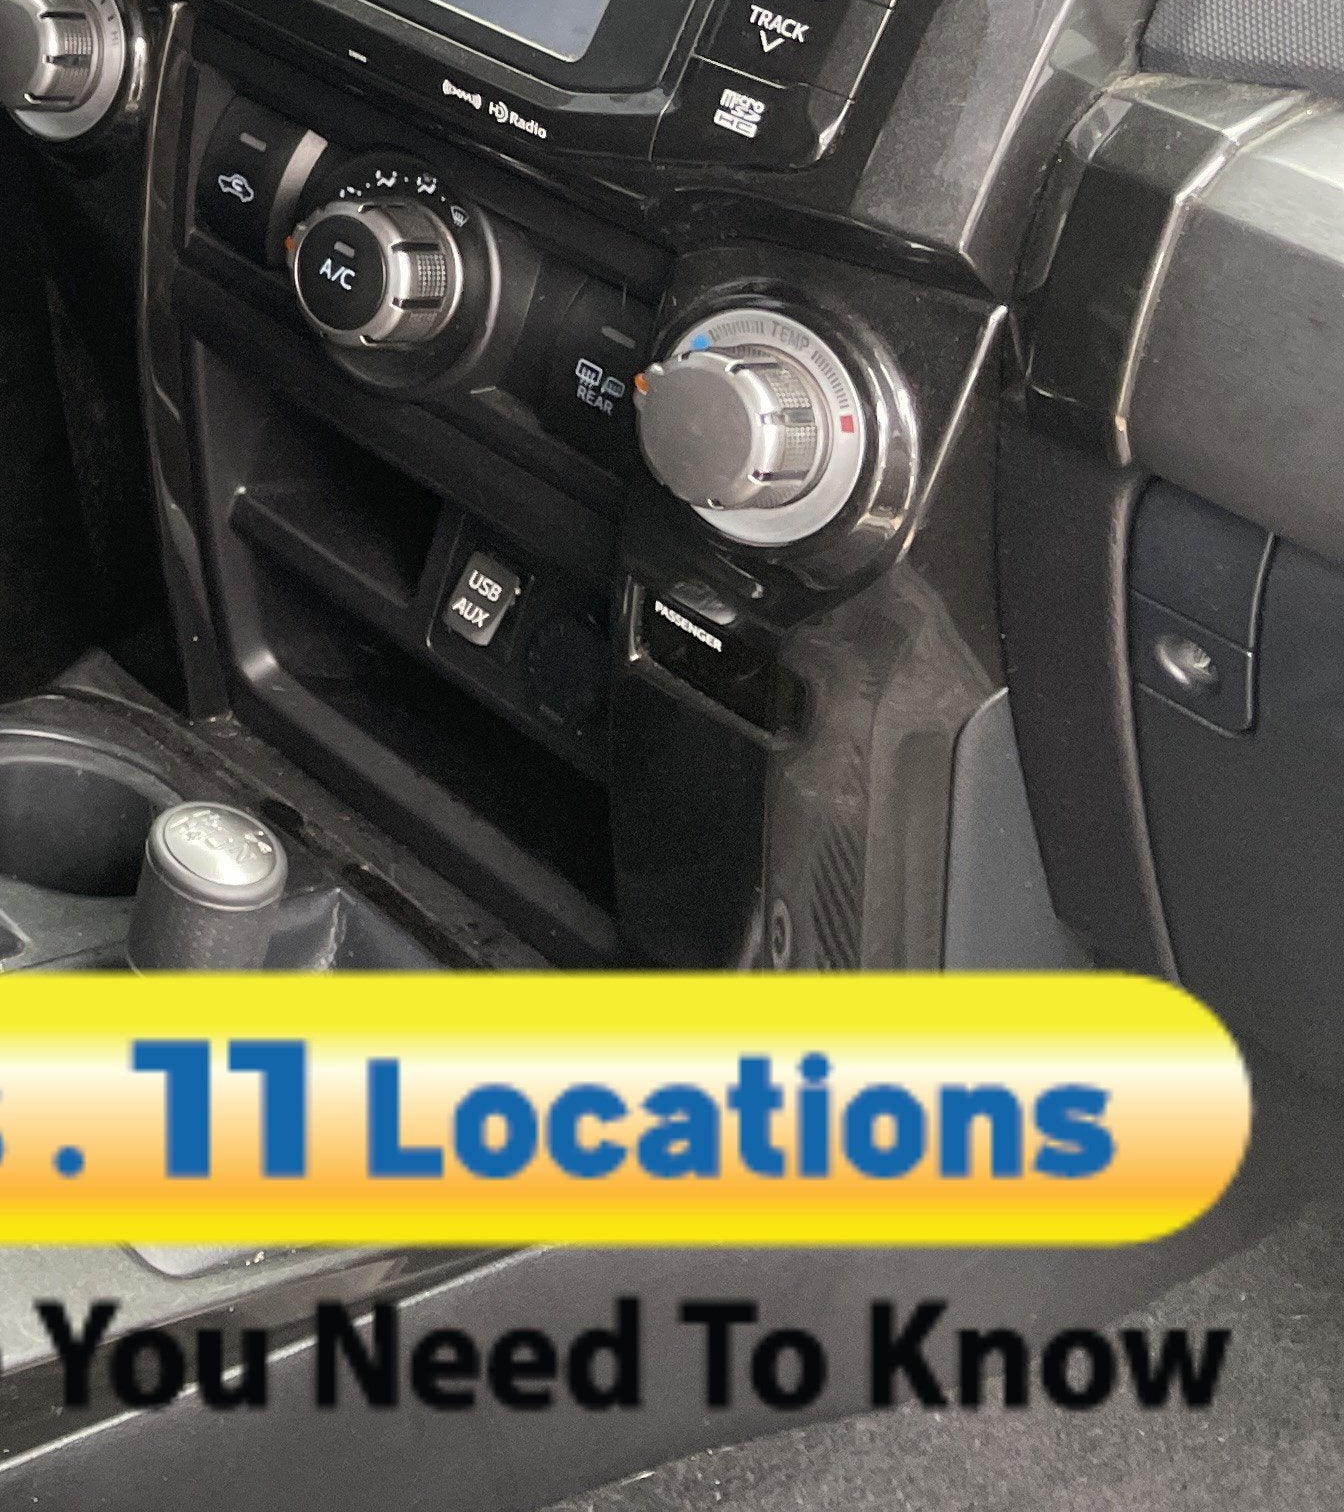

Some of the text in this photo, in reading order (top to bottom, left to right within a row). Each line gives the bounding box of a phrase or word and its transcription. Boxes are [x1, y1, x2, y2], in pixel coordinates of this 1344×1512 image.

[749, 4, 810, 43] TRACK
[509, 110, 548, 139] Radio
[319, 257, 356, 290] A/C
[770, 320, 810, 352] TEMP
[576, 385, 613, 416] REAR
[468, 570, 502, 602] USB
[451, 597, 490, 628] AUX
